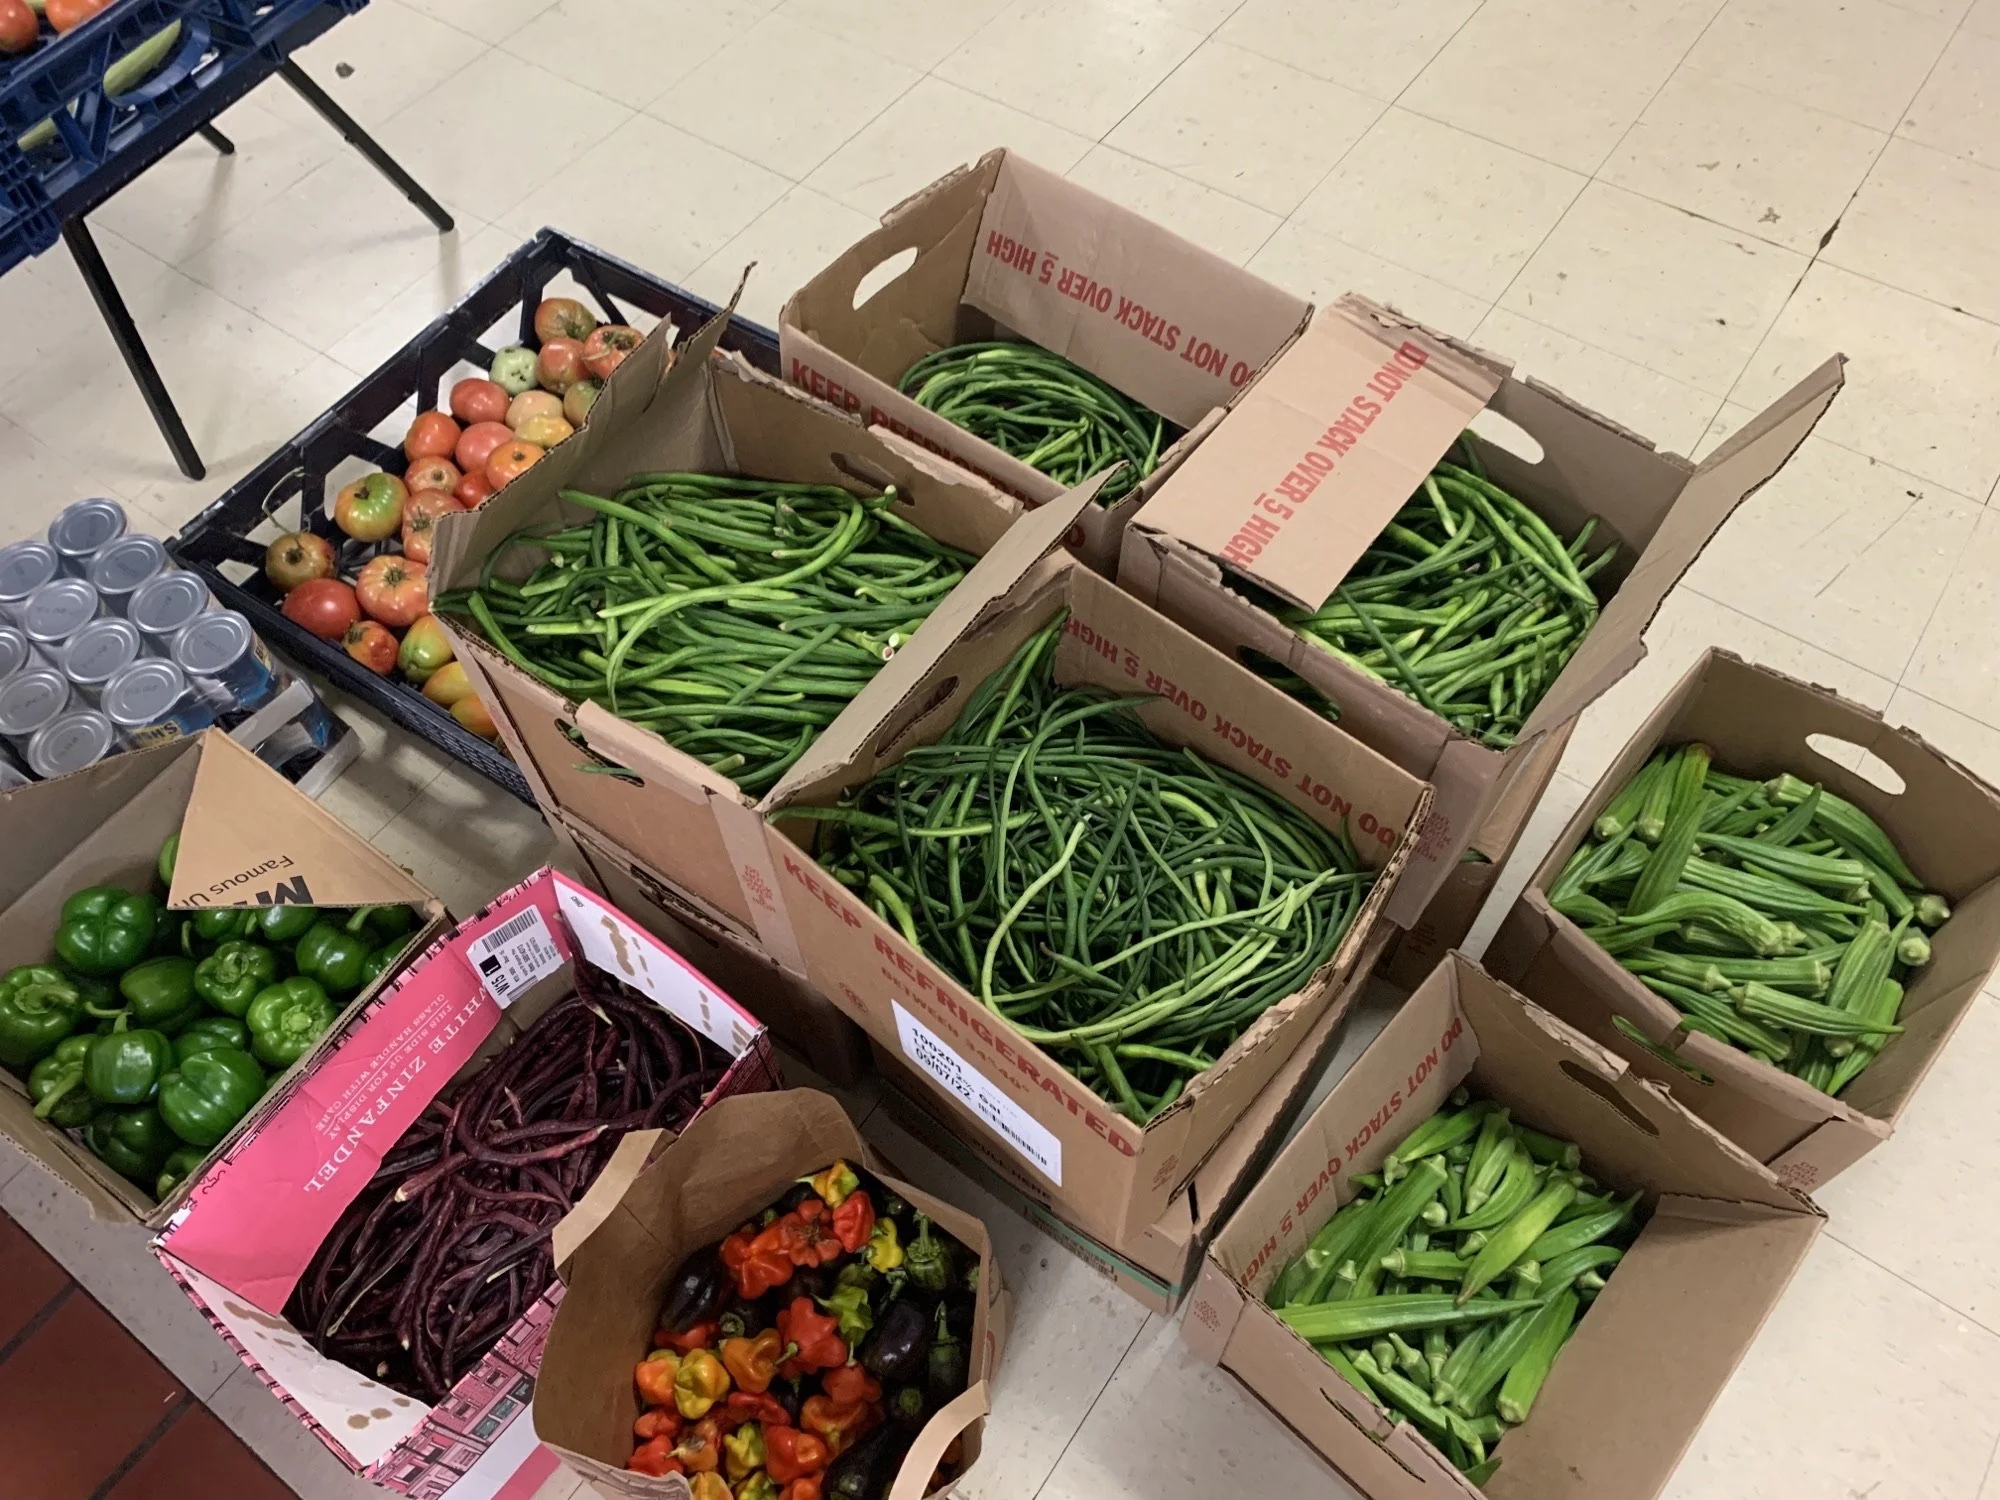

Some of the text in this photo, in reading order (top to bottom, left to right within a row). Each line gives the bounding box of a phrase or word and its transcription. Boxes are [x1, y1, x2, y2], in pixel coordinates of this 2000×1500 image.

[986, 230, 1036, 275] HIGH
[1038, 252, 1059, 286] 5
[1057, 268, 1113, 313] OVER
[1113, 296, 1181, 351] STACK
[1180, 336, 1229, 378] NOT
[1366, 362, 1412, 402] NOT
[1316, 395, 1382, 458] STACK
[1274, 452, 1335, 503] OVER
[1256, 493, 1294, 520] 5
[1219, 513, 1280, 569] HIGH
[1063, 617, 1118, 664] HIGH
[1124, 648, 1140, 678] 5
[1145, 669, 1207, 722] OVER
[1213, 714, 1292, 778] STACK
[1295, 774, 1353, 817] NOT
[1358, 813, 1396, 849] DO
[209, 855, 294, 895] Famous
[491, 974, 510, 996] W15
[783, 854, 1137, 1158] KEEP REFRIGERATED
[912, 1027, 962, 1074] 100201
[1440, 1017, 1464, 1053] DO
[315, 993, 446, 1132] GLASS HANDLE WITH CARE
[329, 1003, 454, 1140] THIS SIDE UP FOR DISPLAY
[914, 1047, 973, 1102] 09/07/22
[1407, 1047, 1439, 1098] NOT
[304, 986, 486, 1193] WHITE ZINFANDEL
[978, 1092, 1002, 1116] Gal
[1345, 1091, 1403, 1161] STACK
[1296, 1157, 1342, 1216] OVER
[1280, 1209, 1294, 1237] 5
